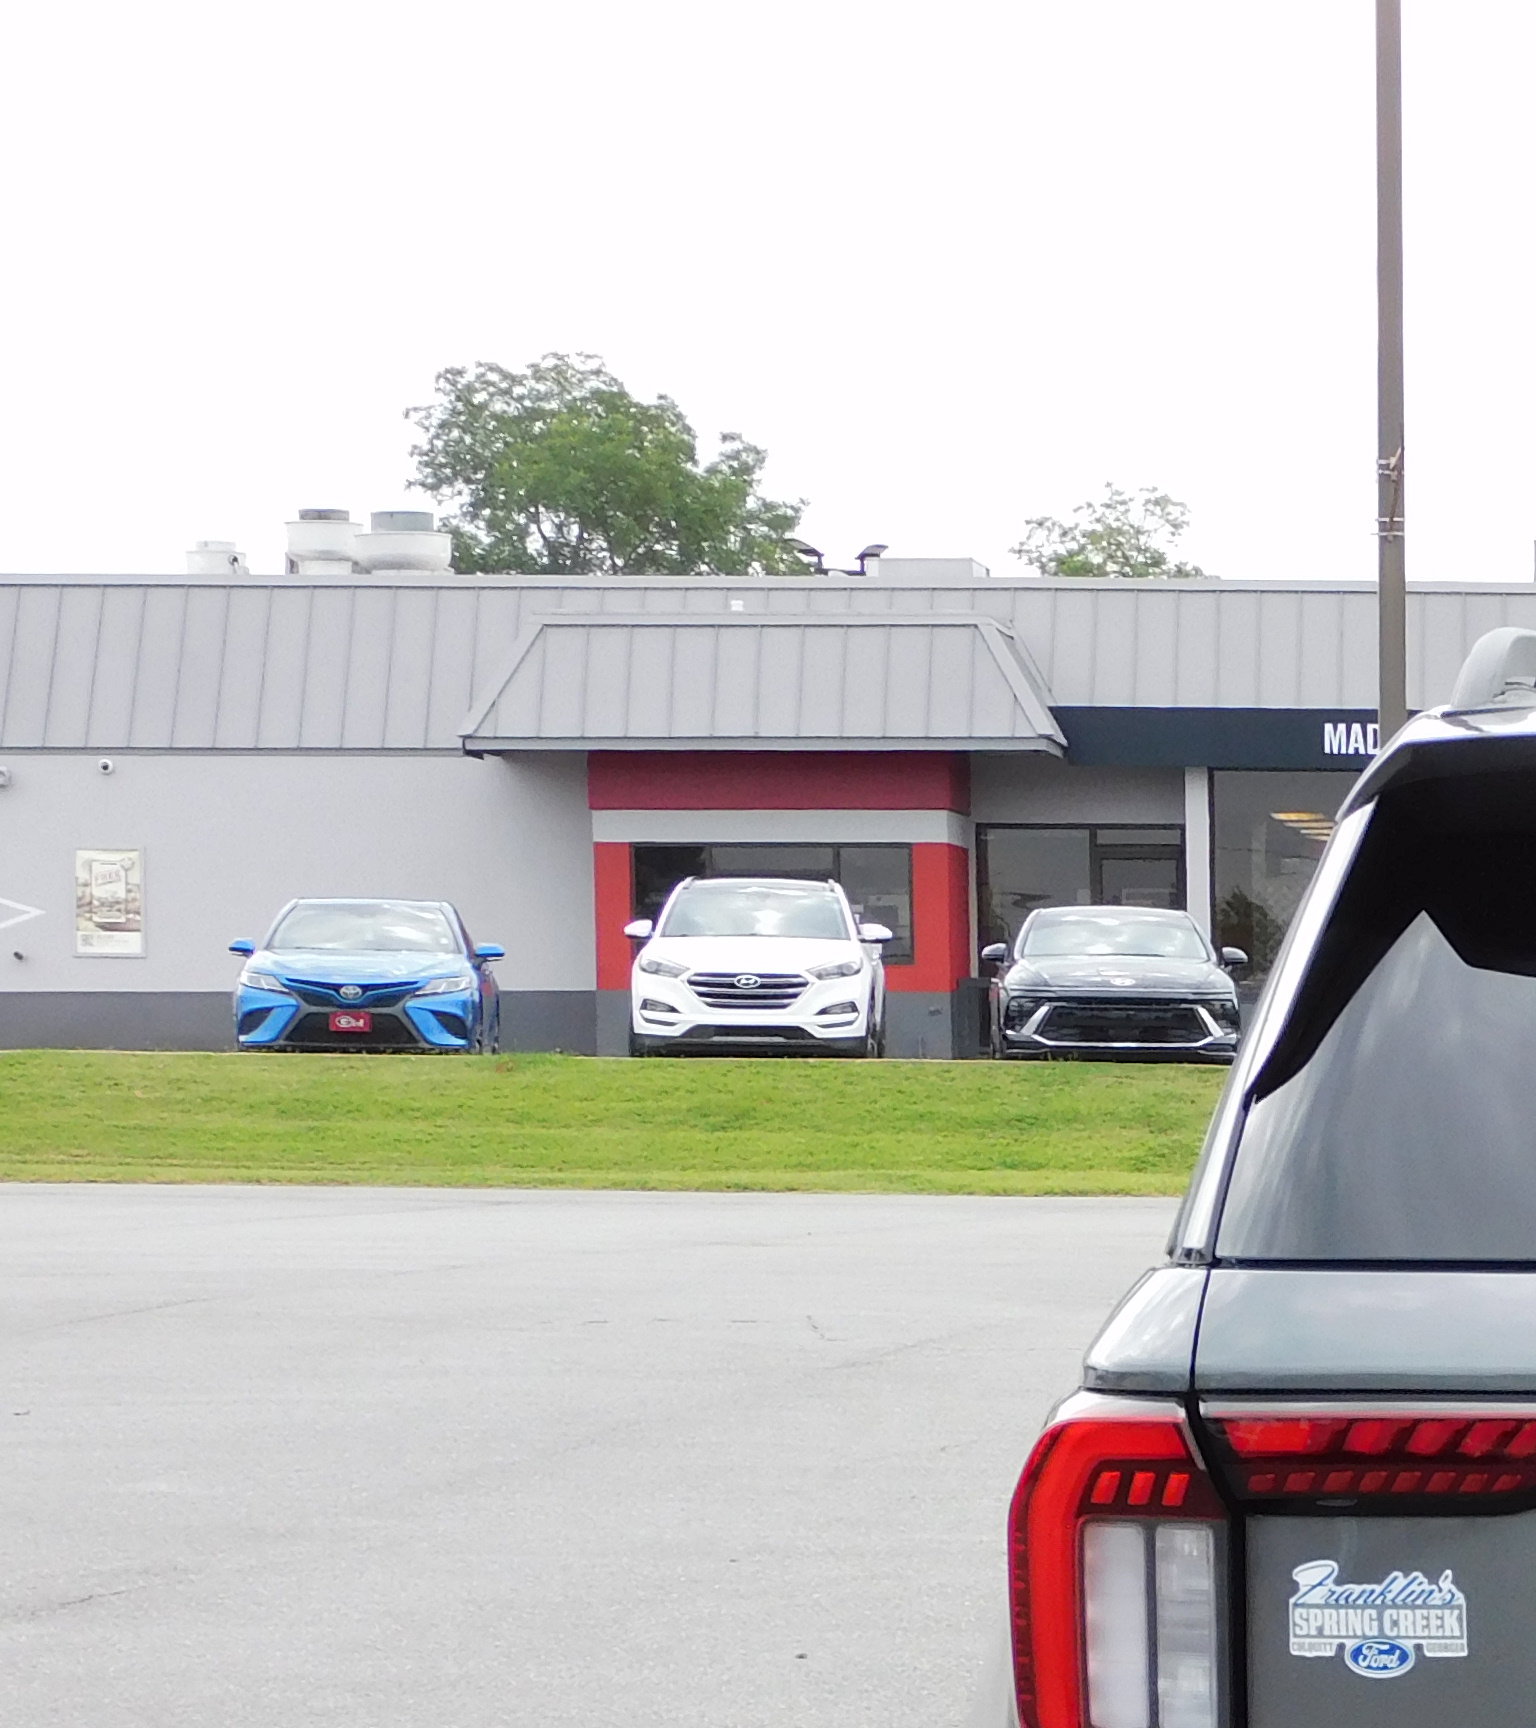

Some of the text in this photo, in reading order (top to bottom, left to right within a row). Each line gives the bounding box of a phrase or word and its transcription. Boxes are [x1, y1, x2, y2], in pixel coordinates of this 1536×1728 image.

[1293, 1562, 1458, 1606] Franklin's
[1294, 1608, 1461, 1638] SPRING CREEK
[1357, 1642, 1400, 1670] Ford
